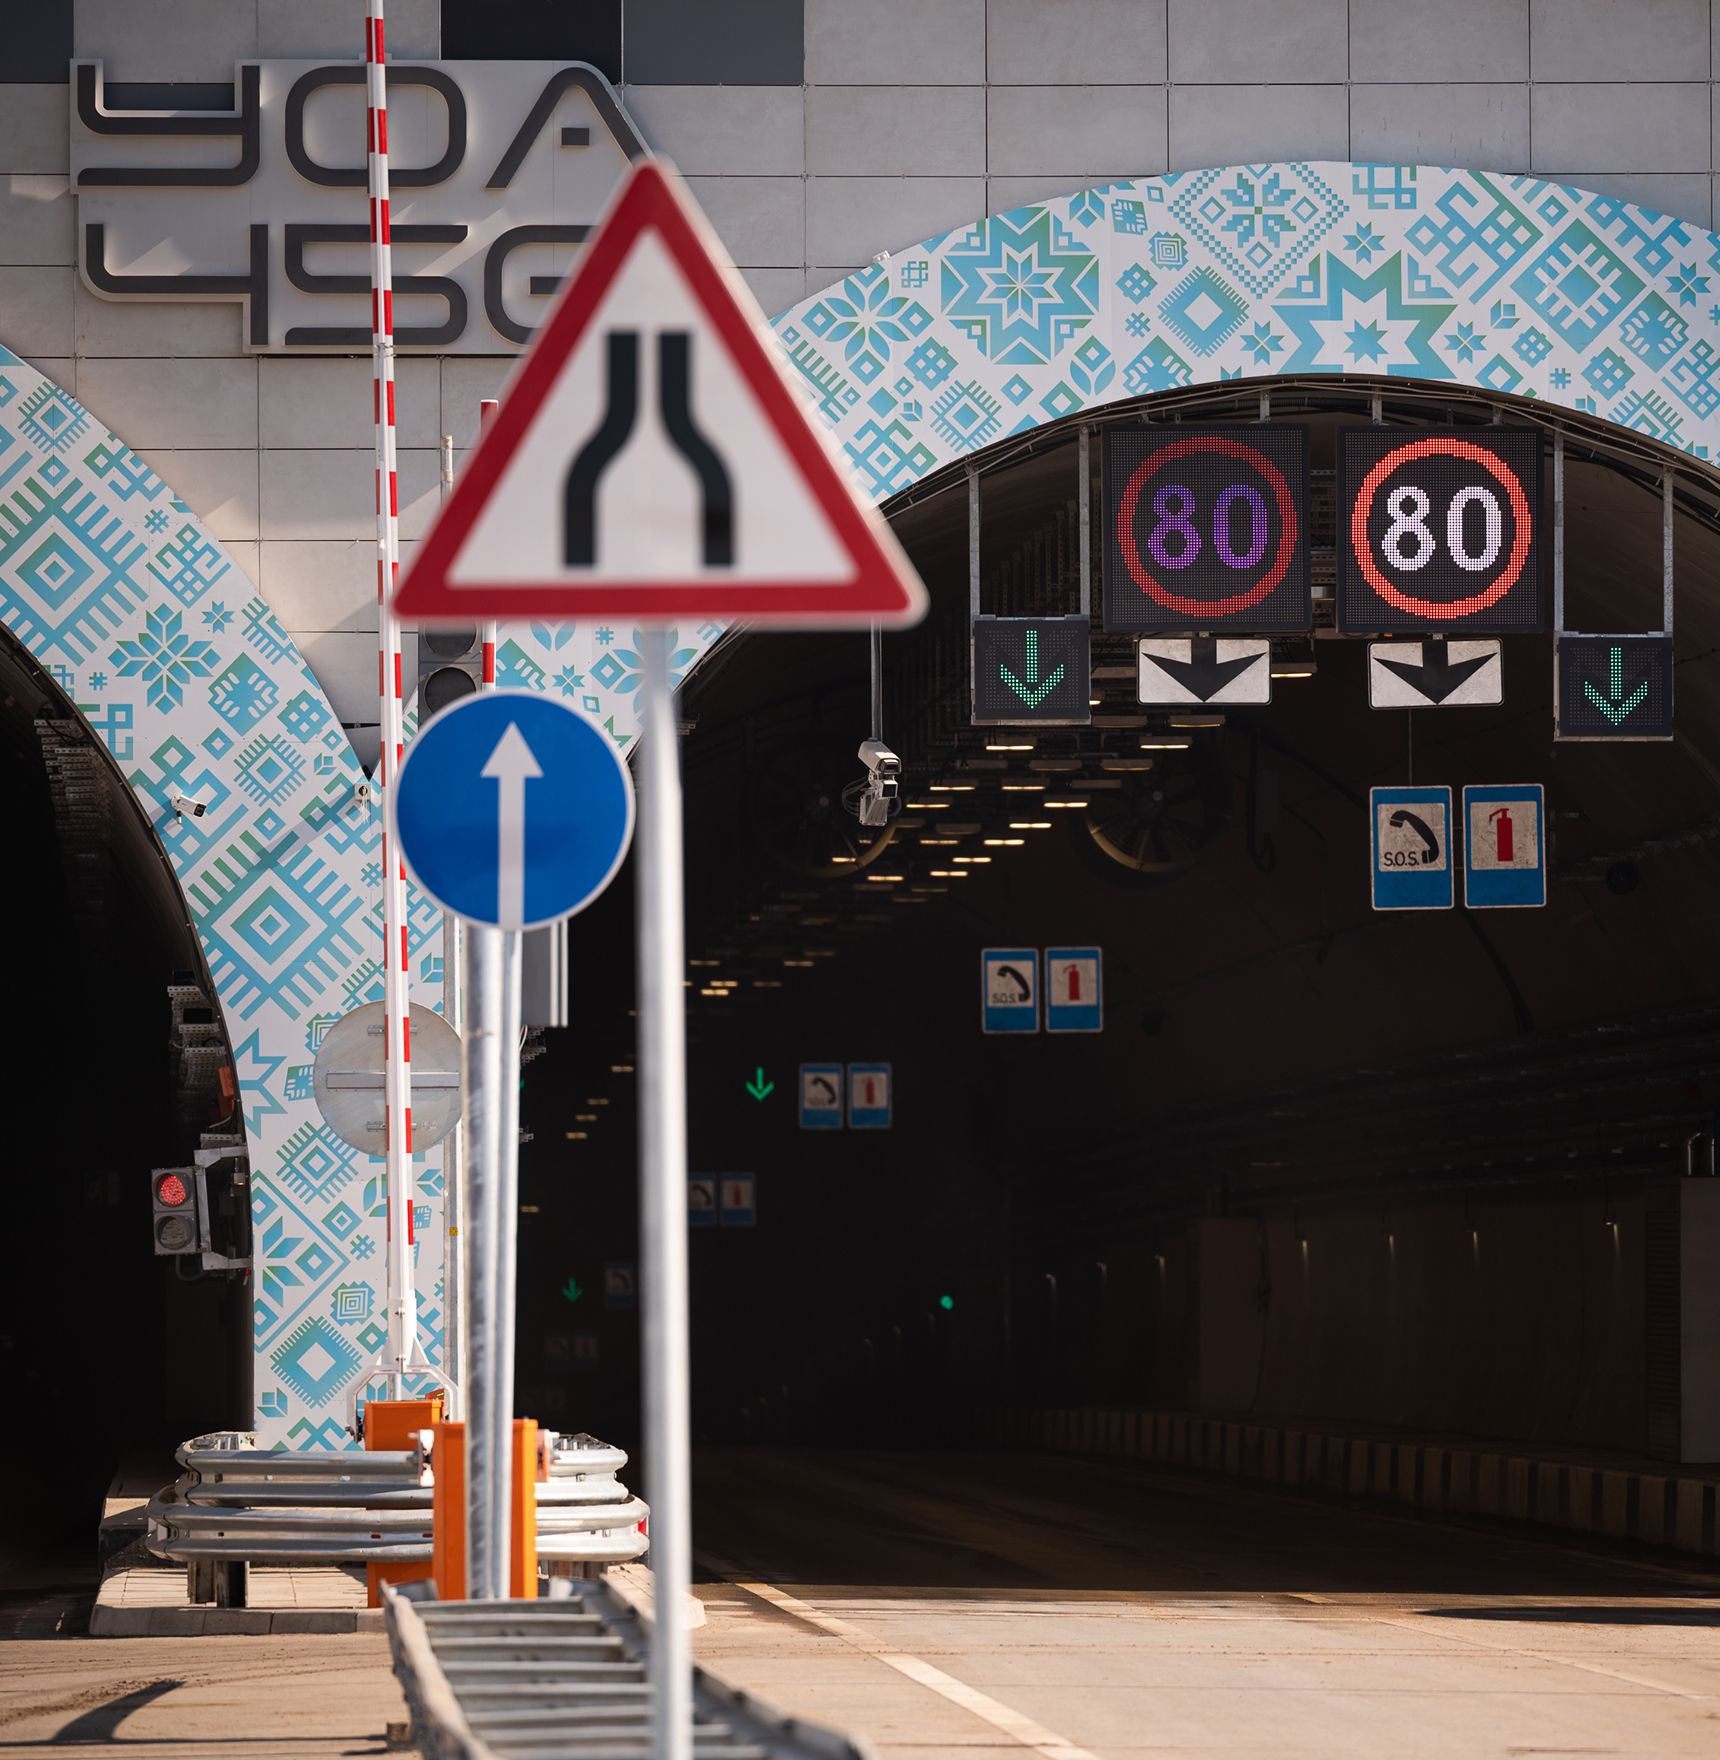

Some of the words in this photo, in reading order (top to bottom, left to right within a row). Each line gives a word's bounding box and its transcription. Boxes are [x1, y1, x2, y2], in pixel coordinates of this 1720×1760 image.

[1148, 484, 1268, 569] 80
[1382, 486, 1501, 571] 80
[1384, 851, 1420, 867] S.O.S.
